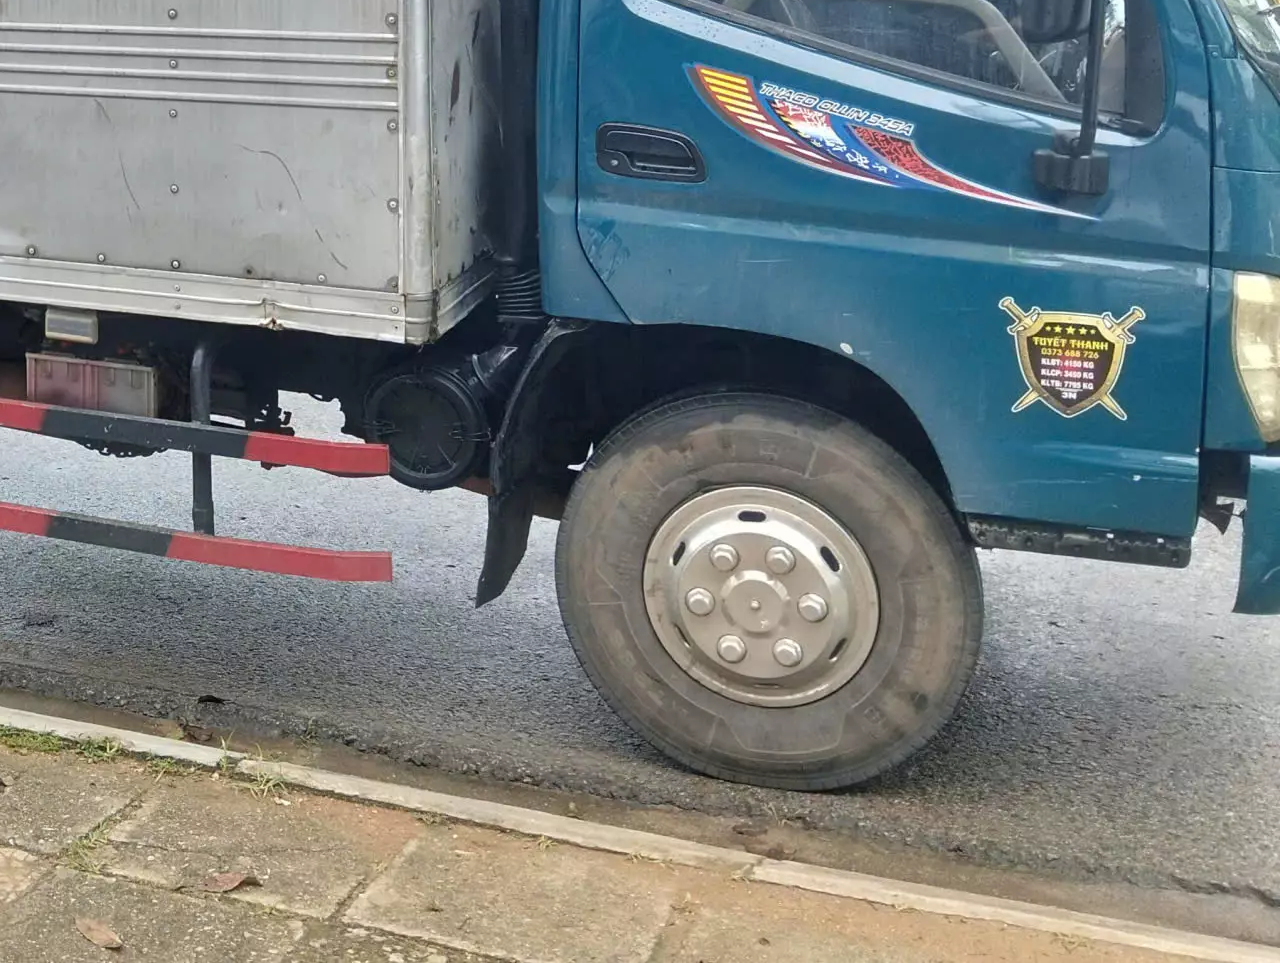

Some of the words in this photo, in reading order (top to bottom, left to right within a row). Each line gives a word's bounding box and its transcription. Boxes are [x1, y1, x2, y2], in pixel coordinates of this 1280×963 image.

[759, 82, 819, 108] THACO
[816, 99, 868, 123] OLLIN
[865, 113, 915, 136] 345A
[1070, 339, 1108, 350] THANH
[1083, 372, 1094, 380] KG
[1083, 382, 1094, 390] KG
